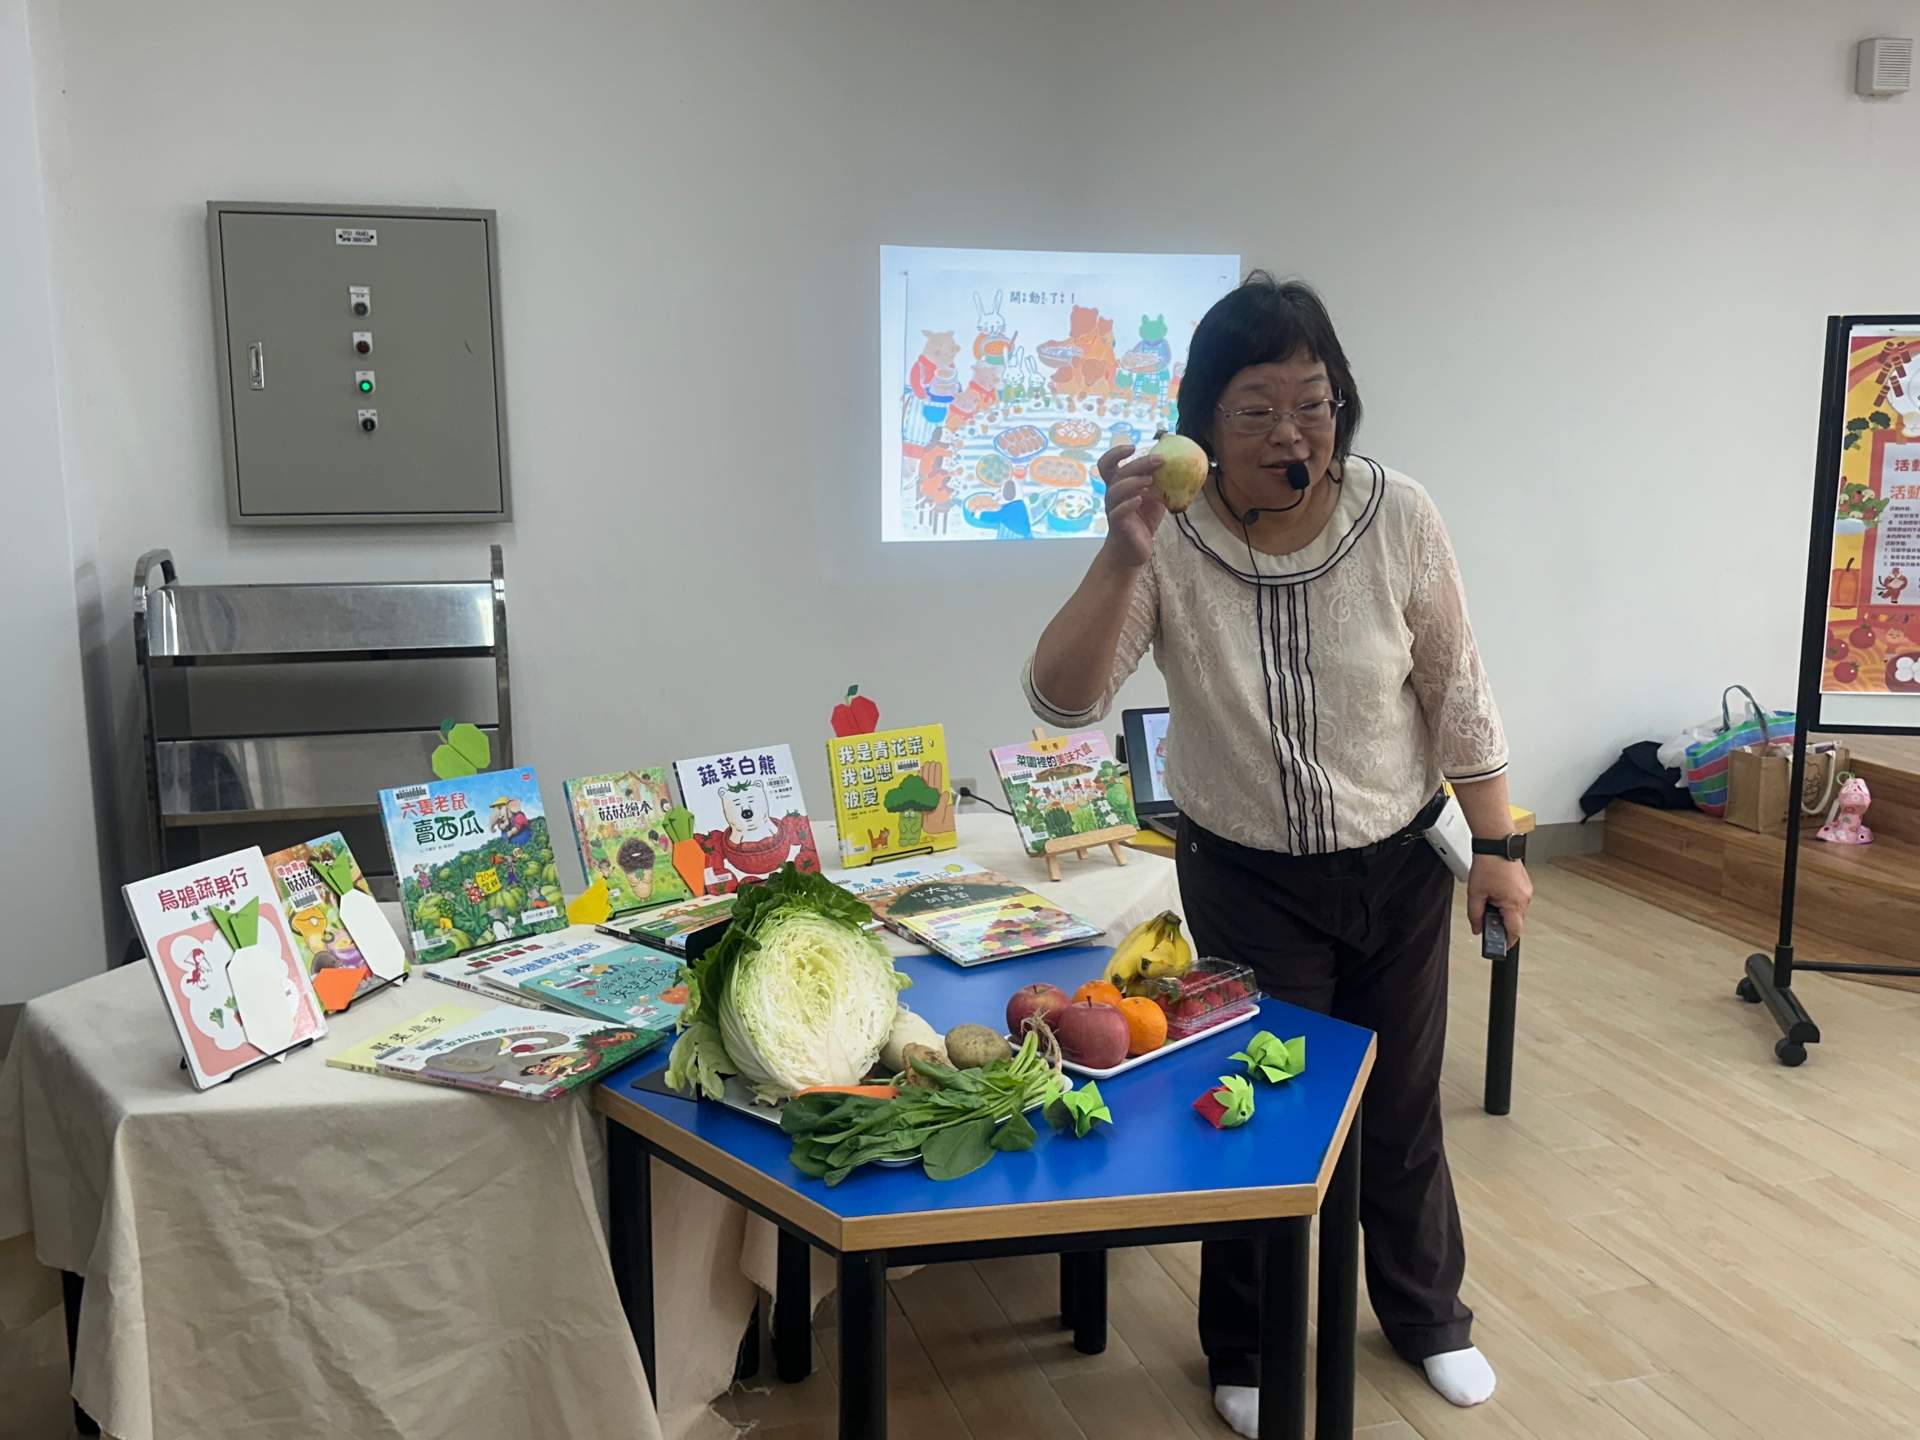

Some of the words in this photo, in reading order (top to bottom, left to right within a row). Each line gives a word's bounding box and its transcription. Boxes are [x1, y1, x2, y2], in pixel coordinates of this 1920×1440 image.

[839, 736, 935, 766] 我是青花菜，
[697, 755, 777, 787] 蔬菜白熊
[841, 762, 893, 788] 我也想
[401, 792, 468, 819] 六隻老鼠
[844, 786, 880, 810] 被愛
[413, 810, 484, 845] 賣西瓜
[158, 866, 249, 913] 烏鴉蔬果行
